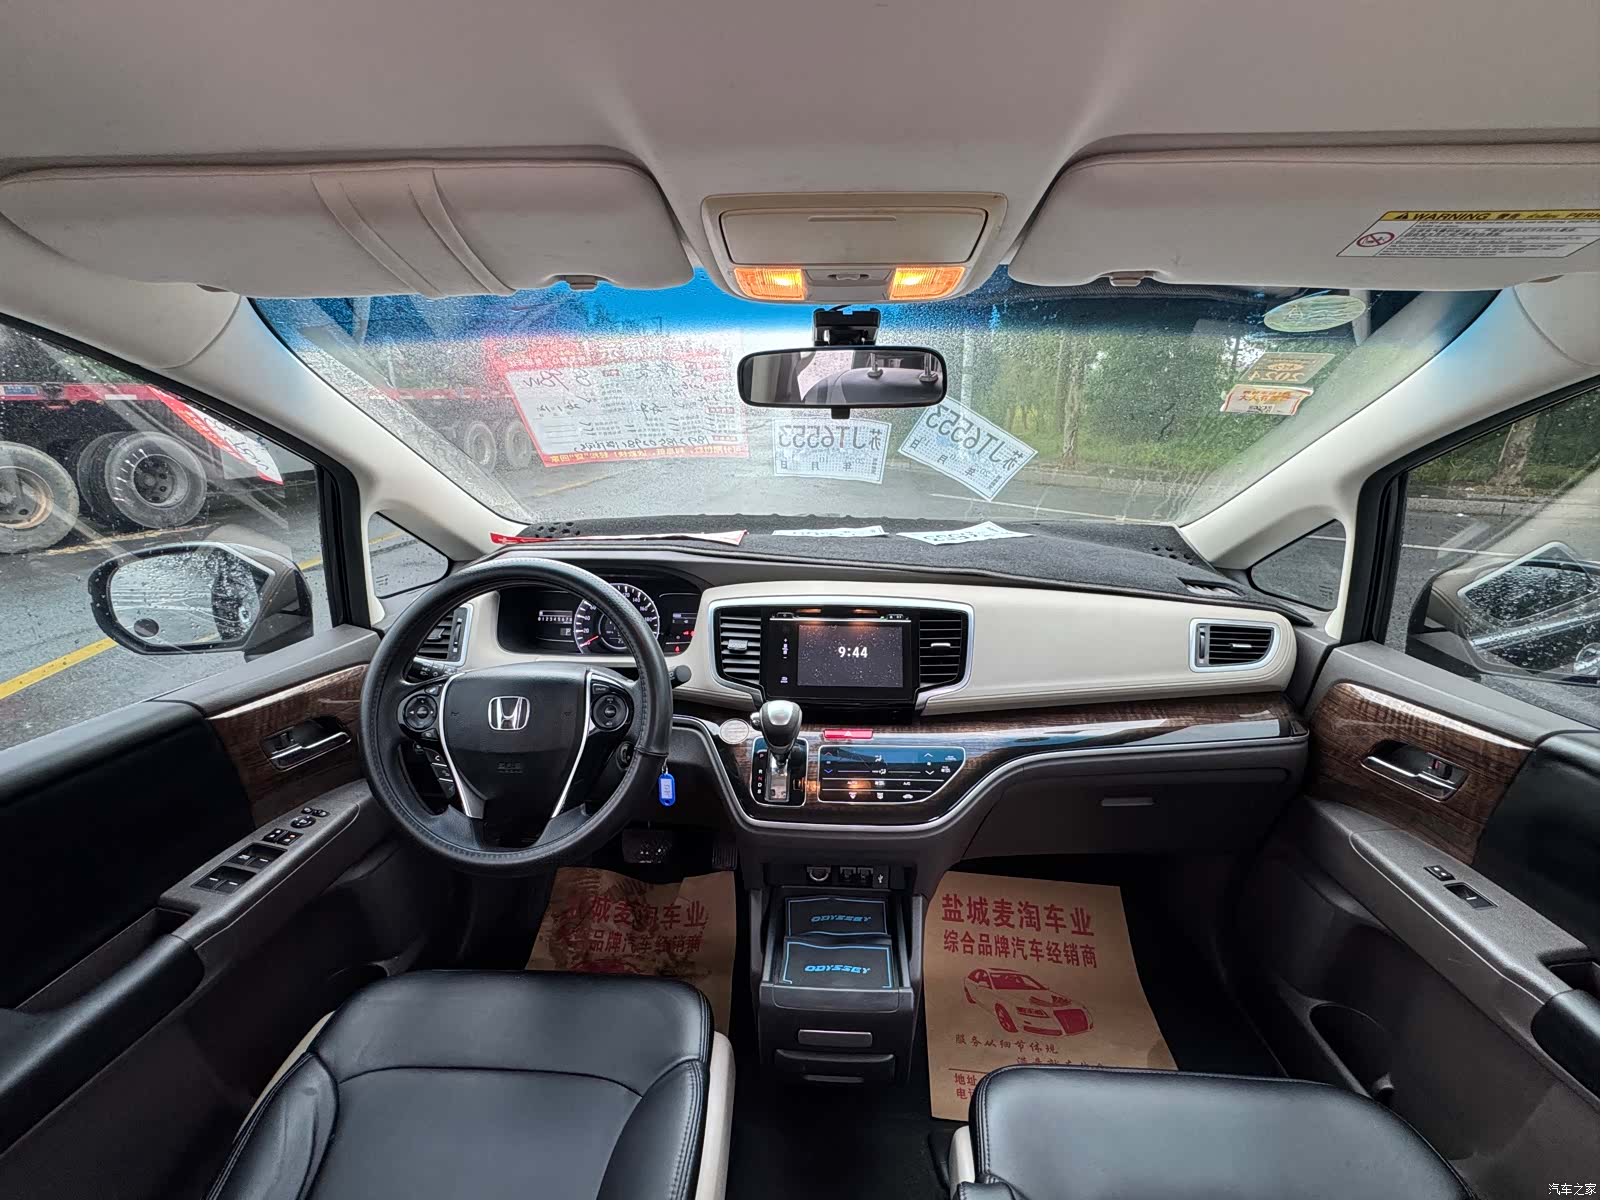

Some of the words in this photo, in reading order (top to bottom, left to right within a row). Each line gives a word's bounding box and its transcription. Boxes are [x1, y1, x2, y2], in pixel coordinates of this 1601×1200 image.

[1413, 212, 1491, 221] WARNING
[838, 646, 869, 659] 9:44
[811, 914, 872, 923] ODYSSEY
[941, 893, 1095, 937] 盐城麦淘车业
[943, 929, 1098, 968] 综合品牌汽车经销商
[804, 964, 871, 974] ODYSSEY
